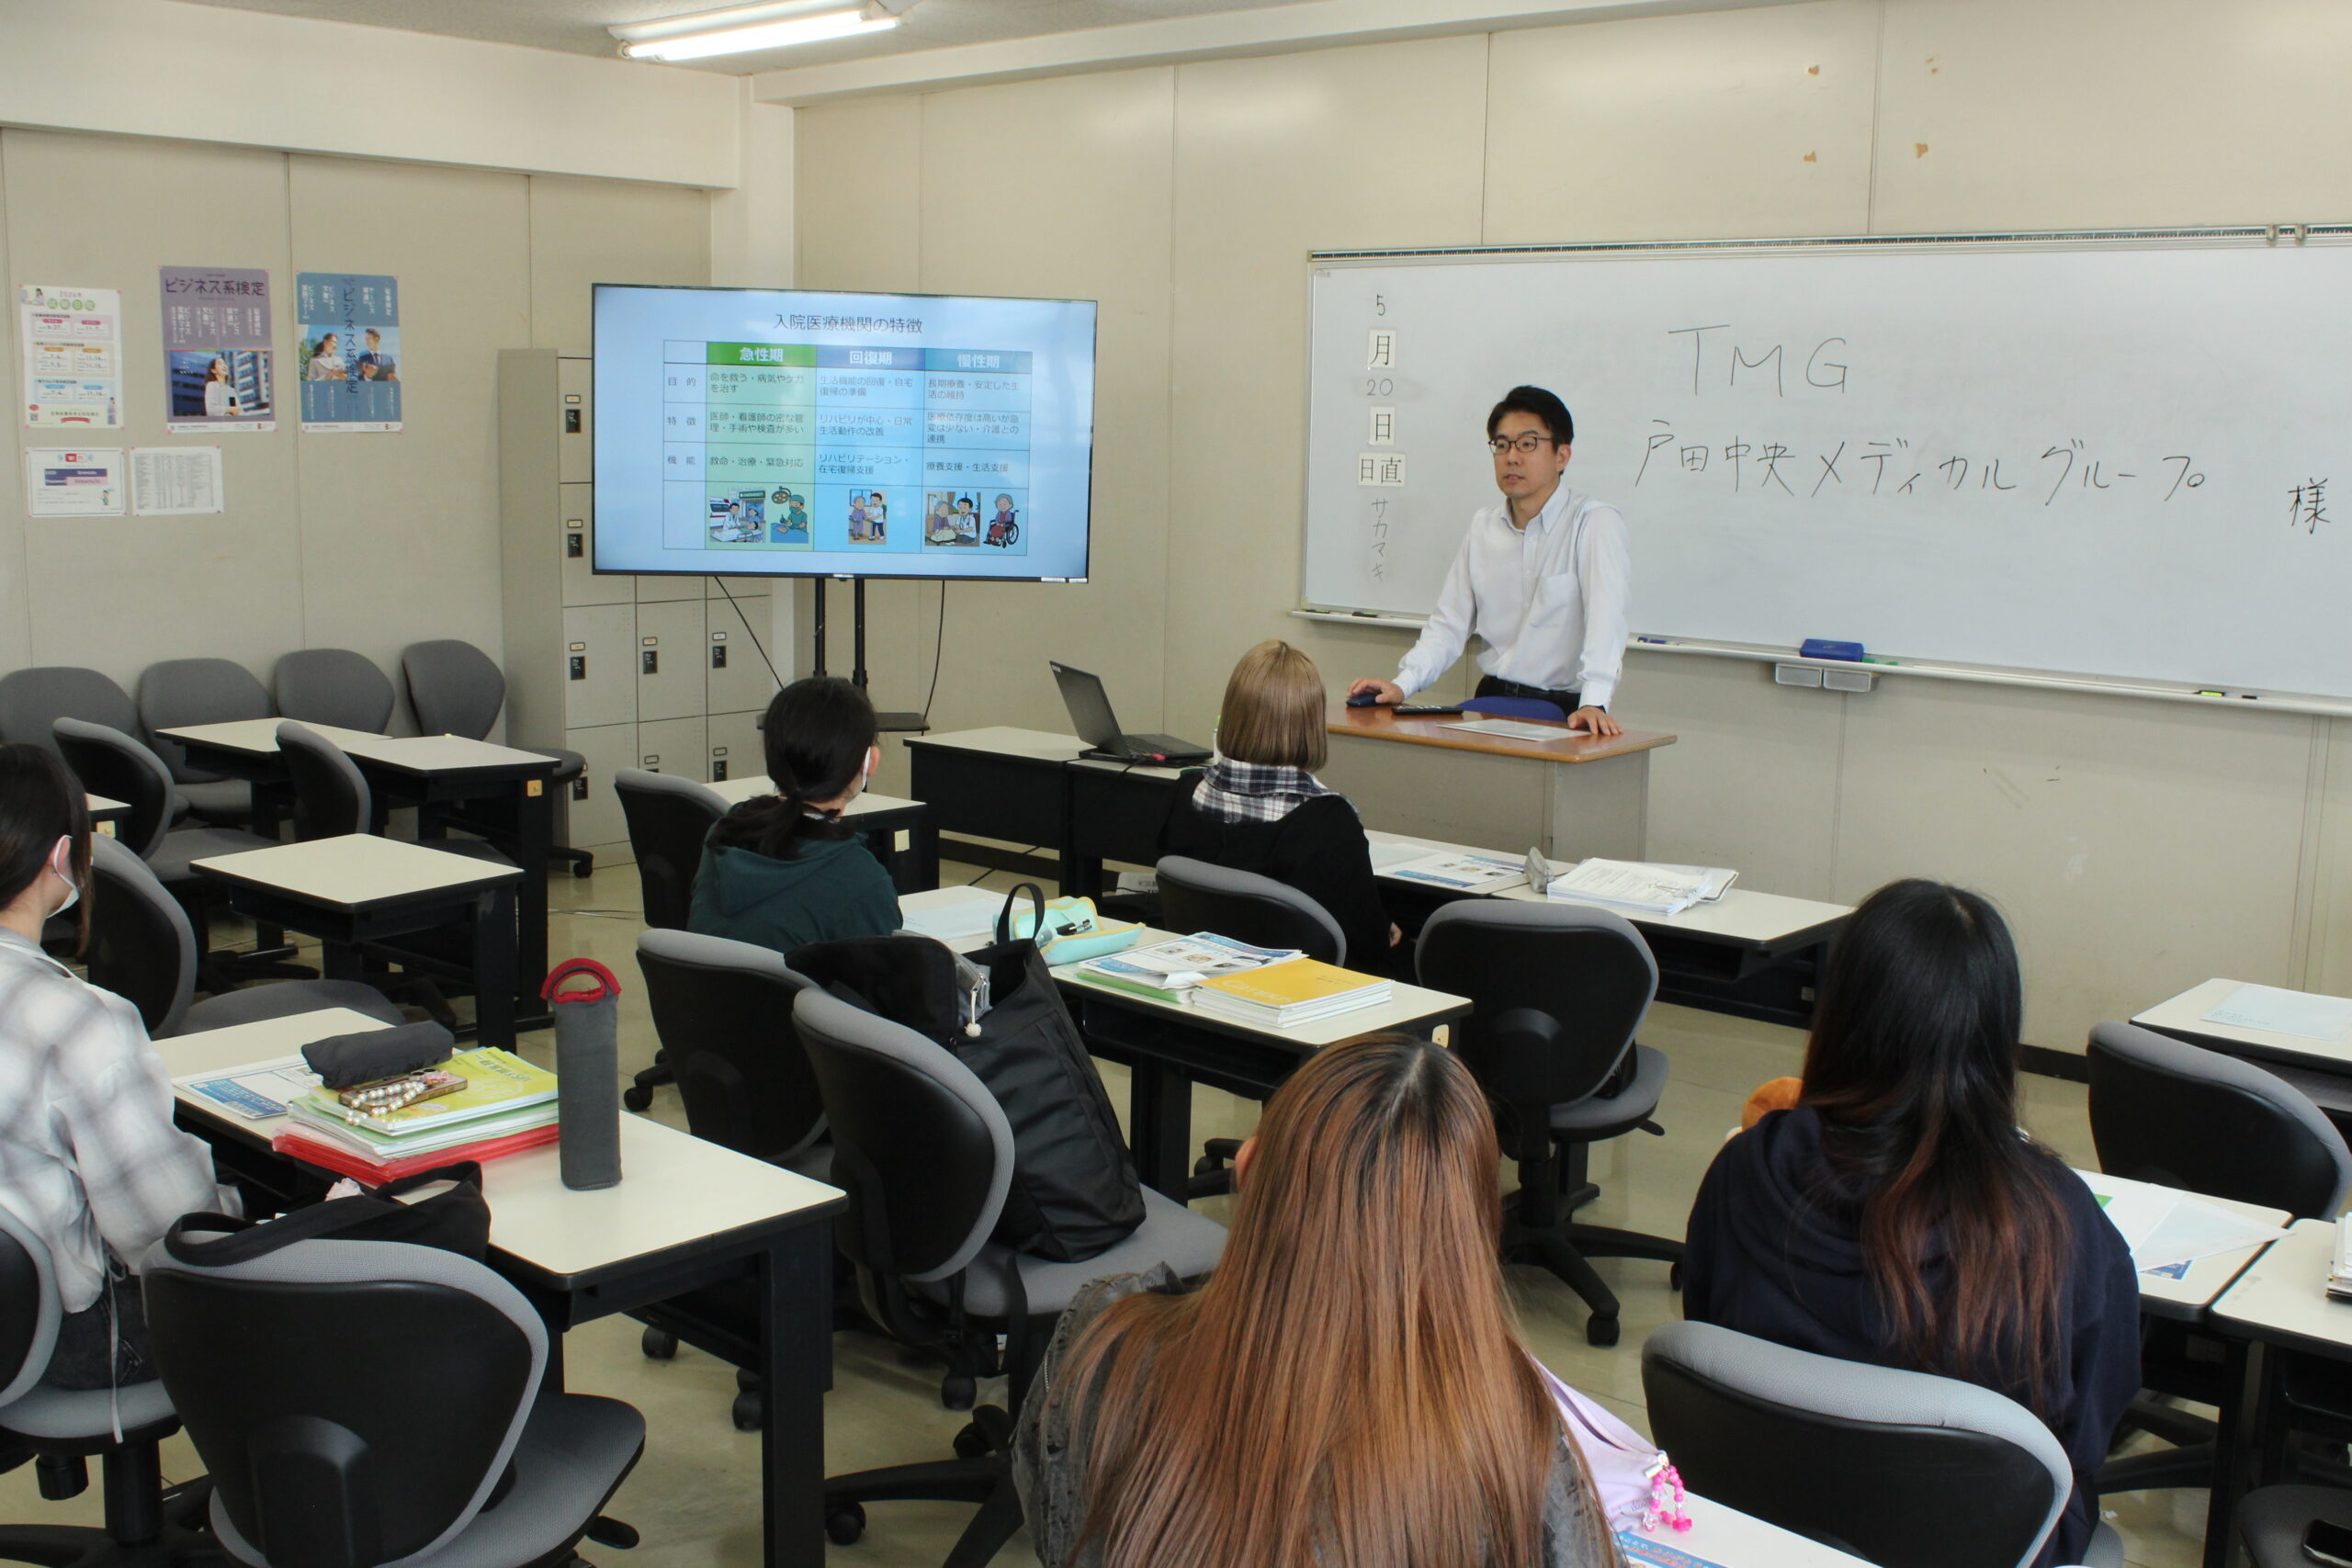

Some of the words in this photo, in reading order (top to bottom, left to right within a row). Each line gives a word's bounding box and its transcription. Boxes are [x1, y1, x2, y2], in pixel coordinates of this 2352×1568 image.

[164, 277, 266, 297] ビジネス系検定
[1375, 293, 1387, 317] 5
[773, 313, 923, 334] 入院医療機関の特徴
[343, 288, 359, 394] ビジネス系検定
[1369, 334, 1391, 367] 月
[739, 346, 785, 363] 急性期
[849, 350, 893, 366] 回復期
[956, 354, 1001, 369] 慢性期
[1668, 324, 1849, 398] TMG
[711, 384, 739, 394] を治す
[1366, 378, 1395, 397] 20
[1374, 412, 1392, 443] 日
[1361, 457, 1403, 485] 日直
[2287, 477, 2331, 535] 様
